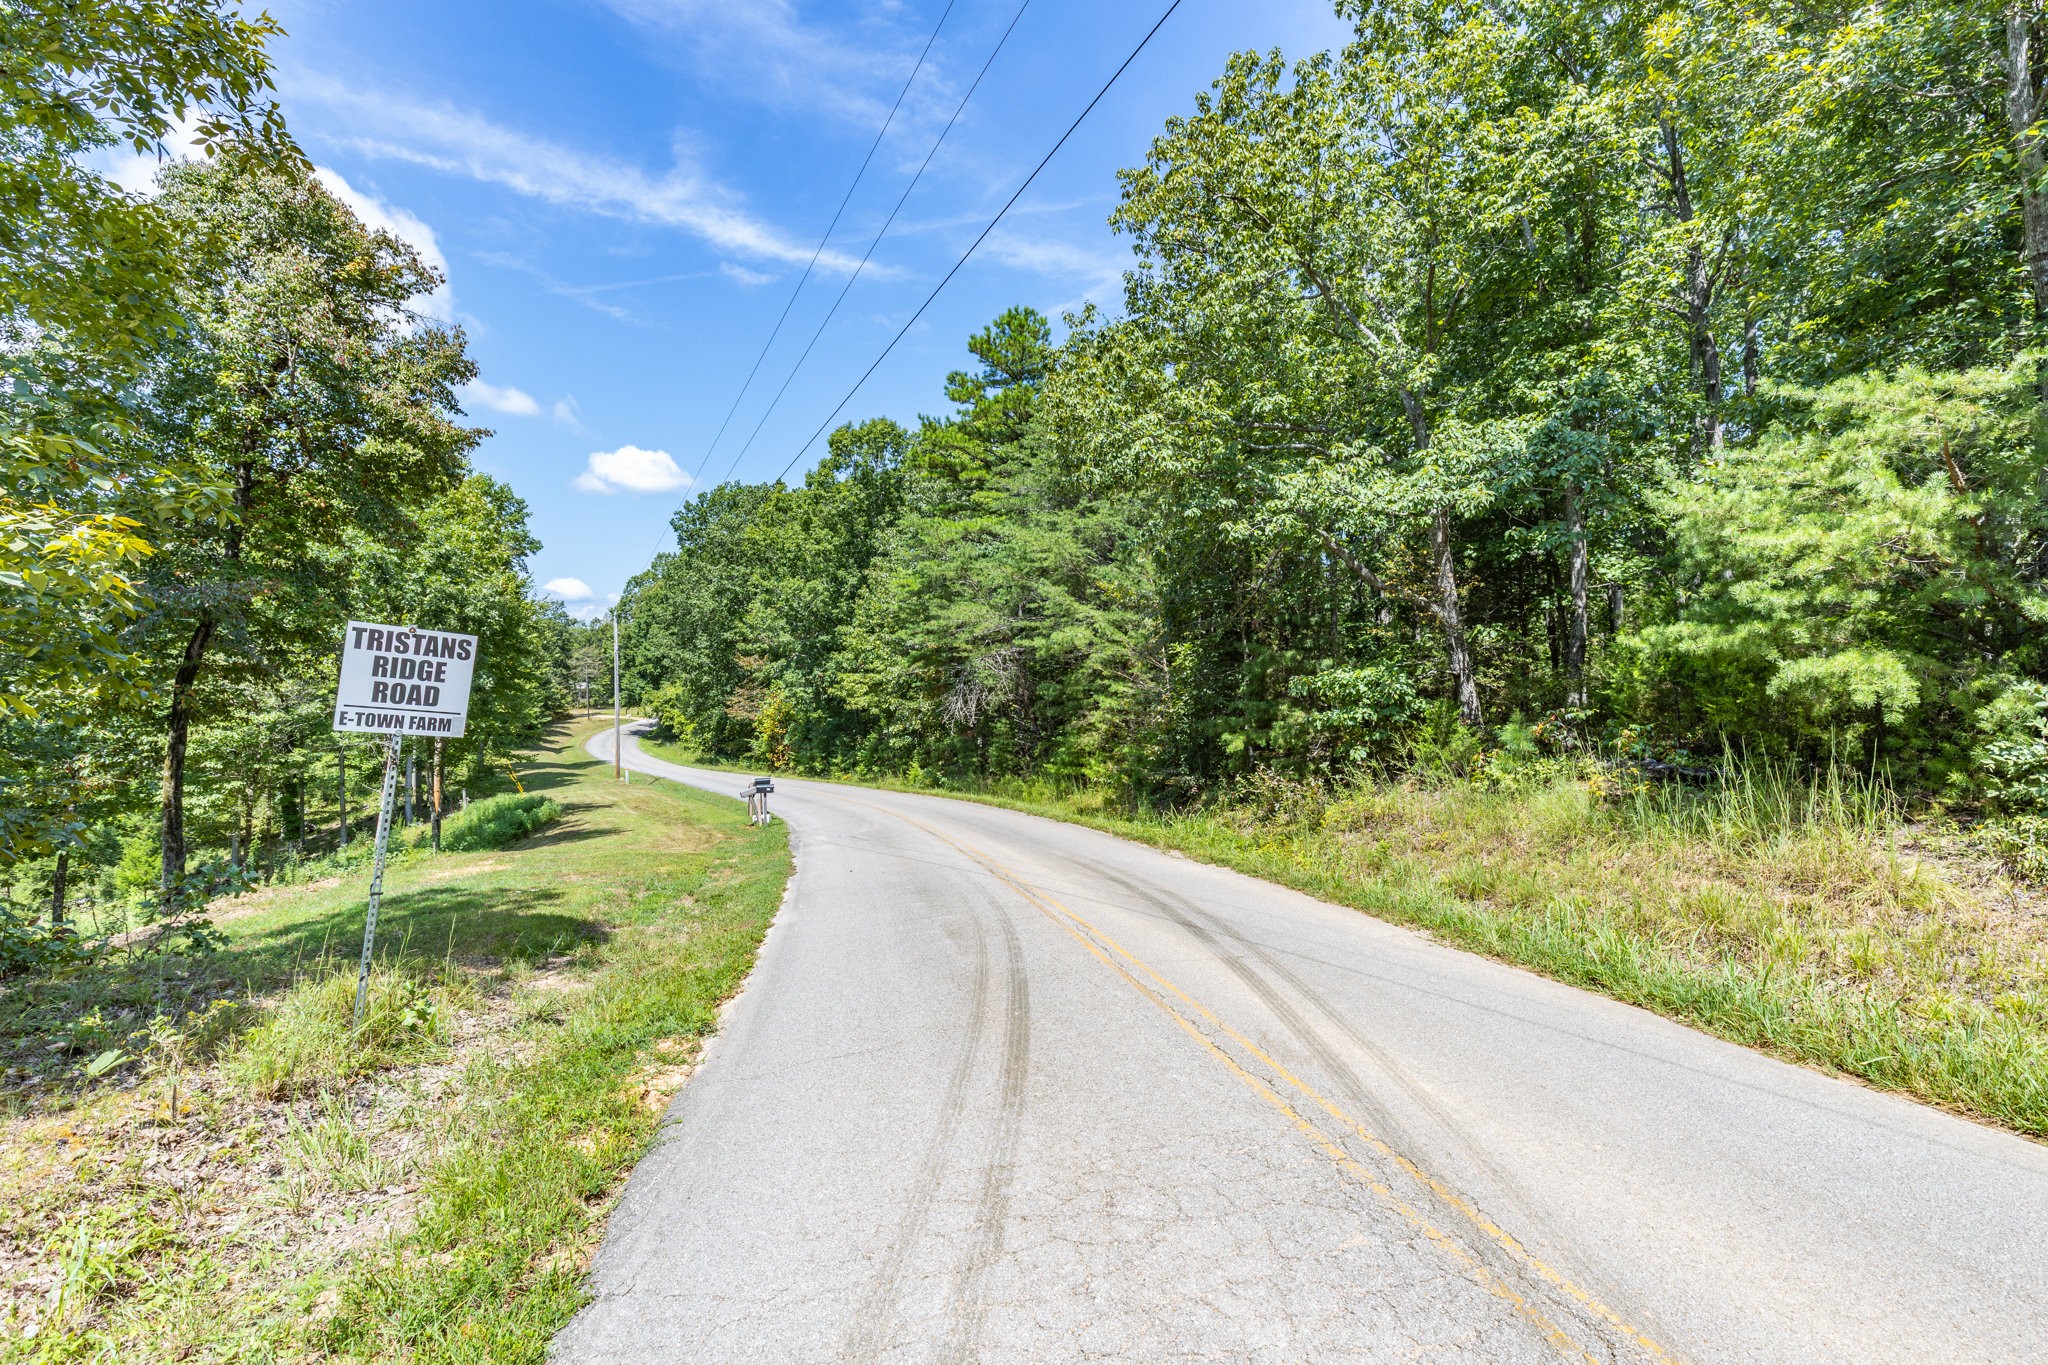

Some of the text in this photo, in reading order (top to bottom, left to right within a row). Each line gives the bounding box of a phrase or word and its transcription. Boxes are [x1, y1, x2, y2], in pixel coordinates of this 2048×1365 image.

[352, 627, 472, 661] TRISTANS
[371, 655, 447, 683] RIDGE
[371, 681, 440, 707] ROAD
[339, 711, 452, 732] E-TOWN FARM
